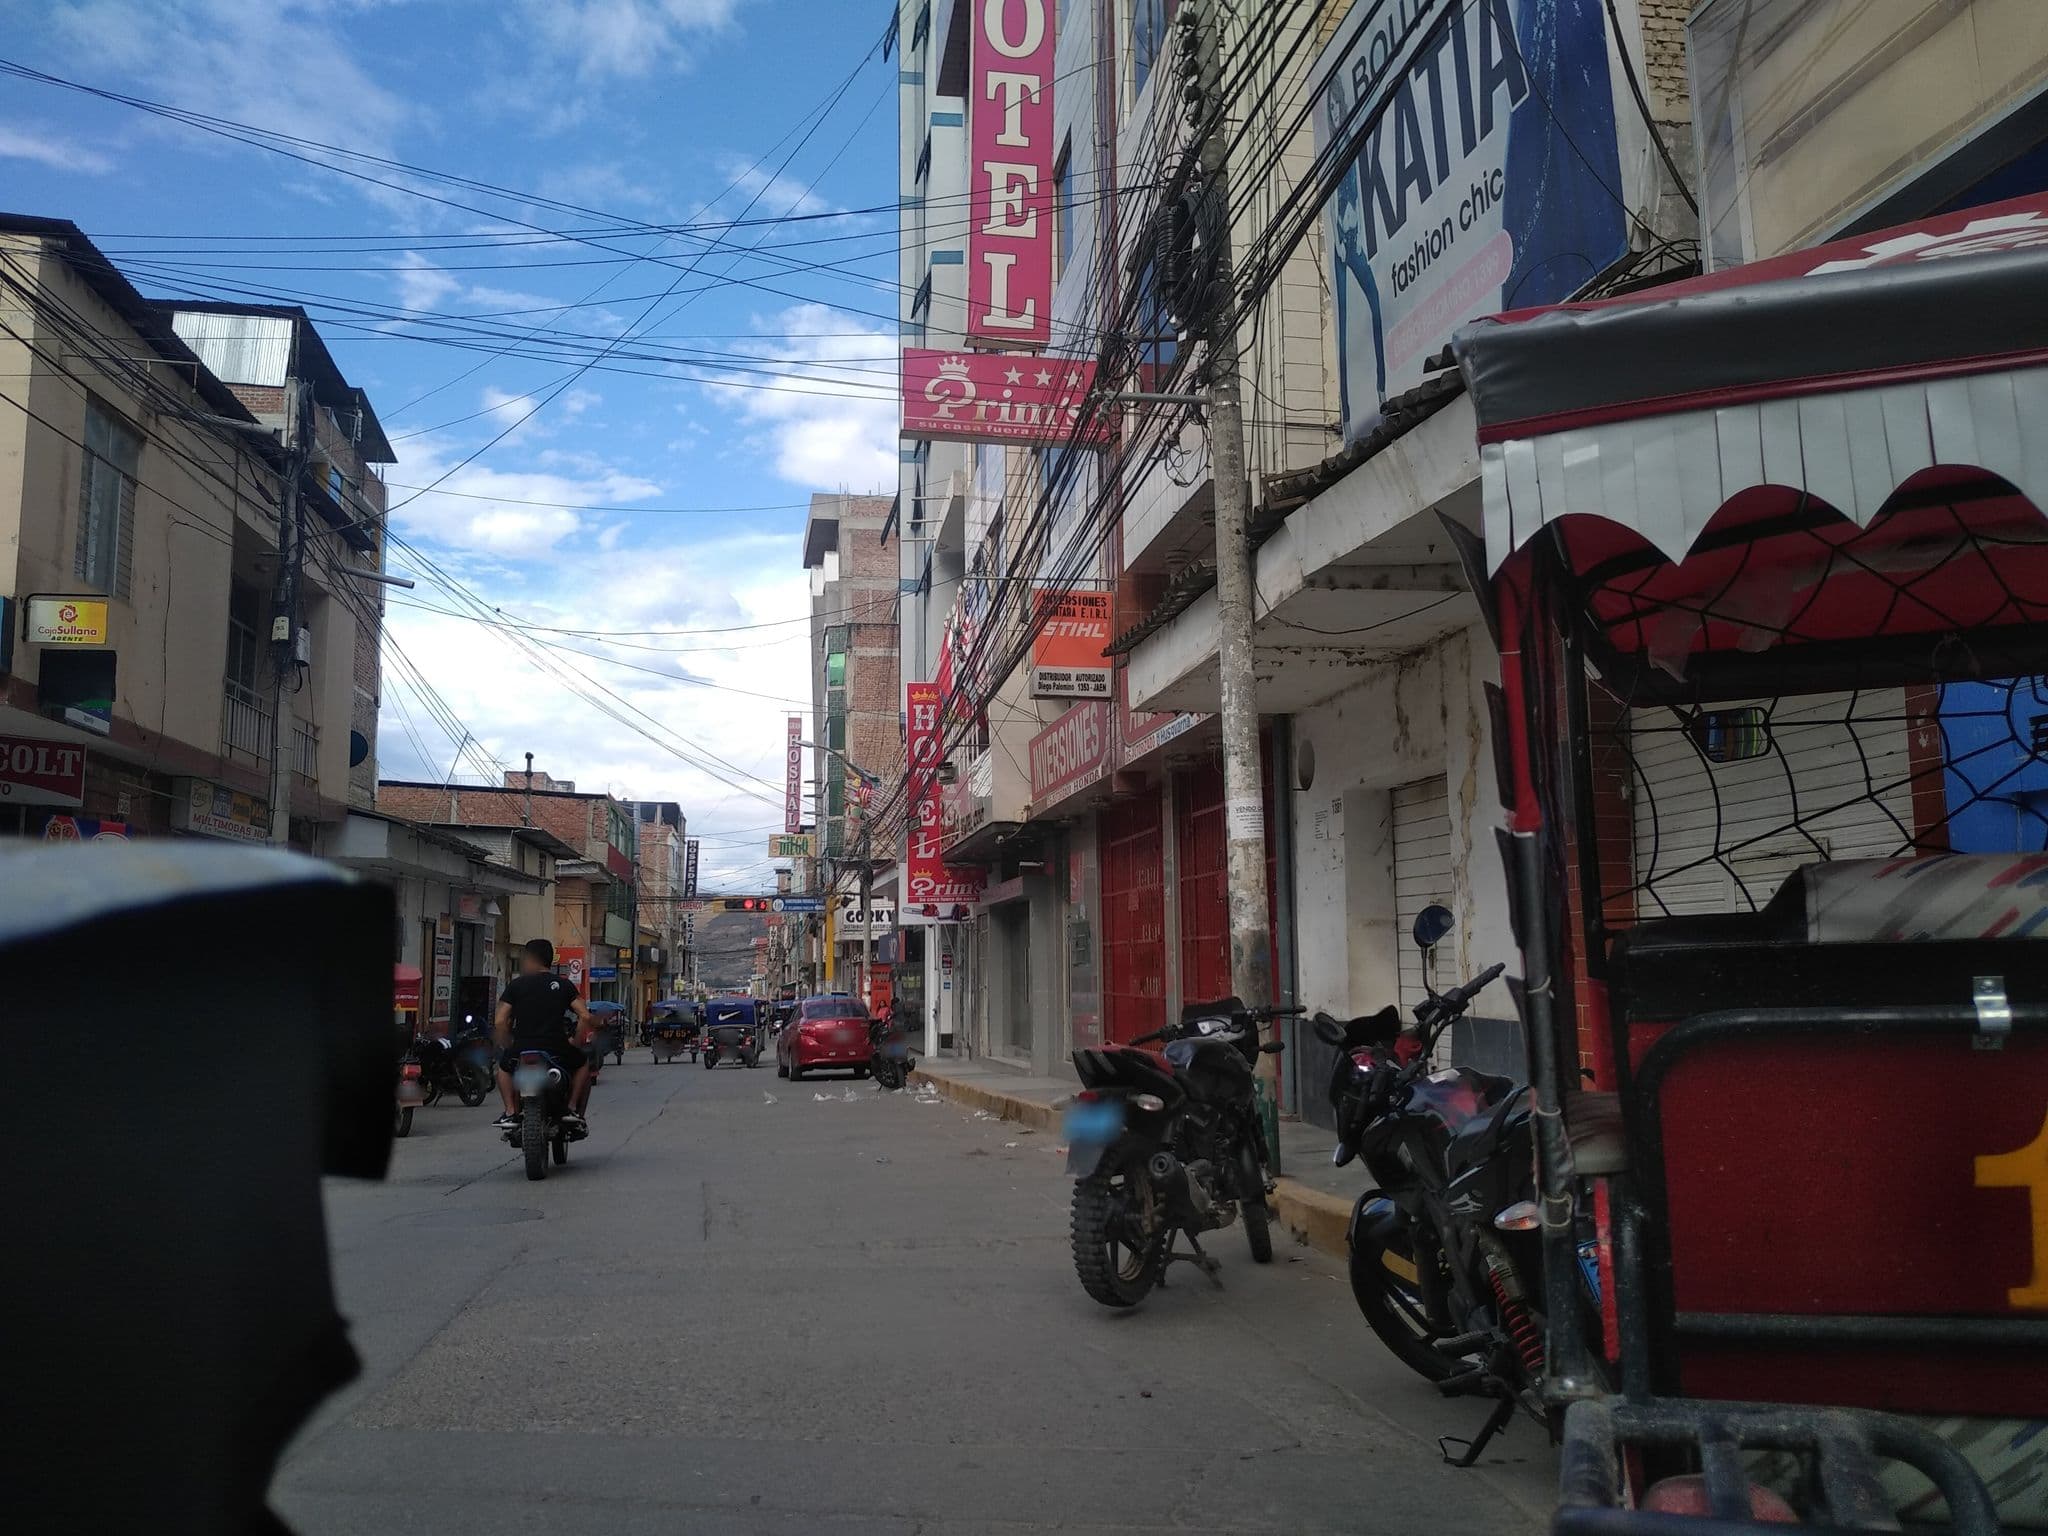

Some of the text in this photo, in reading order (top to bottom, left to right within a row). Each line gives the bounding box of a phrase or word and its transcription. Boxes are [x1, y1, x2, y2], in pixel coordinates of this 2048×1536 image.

[1357, 0, 1522, 261] KATIA
[1391, 167, 1504, 299] fashion chic
[943, 423, 981, 432] casa
[986, 424, 1029, 436] fuera
[1042, 621, 1105, 638] STIHL
[1039, 672, 1105, 682] DISTRIBUIDOR AUTORIZADO
[1033, 701, 1100, 794] INVERSIONES
[787, 734, 800, 826] HOSTAL
[1073, 768, 1100, 792] HONDA
[687, 840, 697, 897] HOSPEDAJE
[846, 910, 895, 923] GORKY
